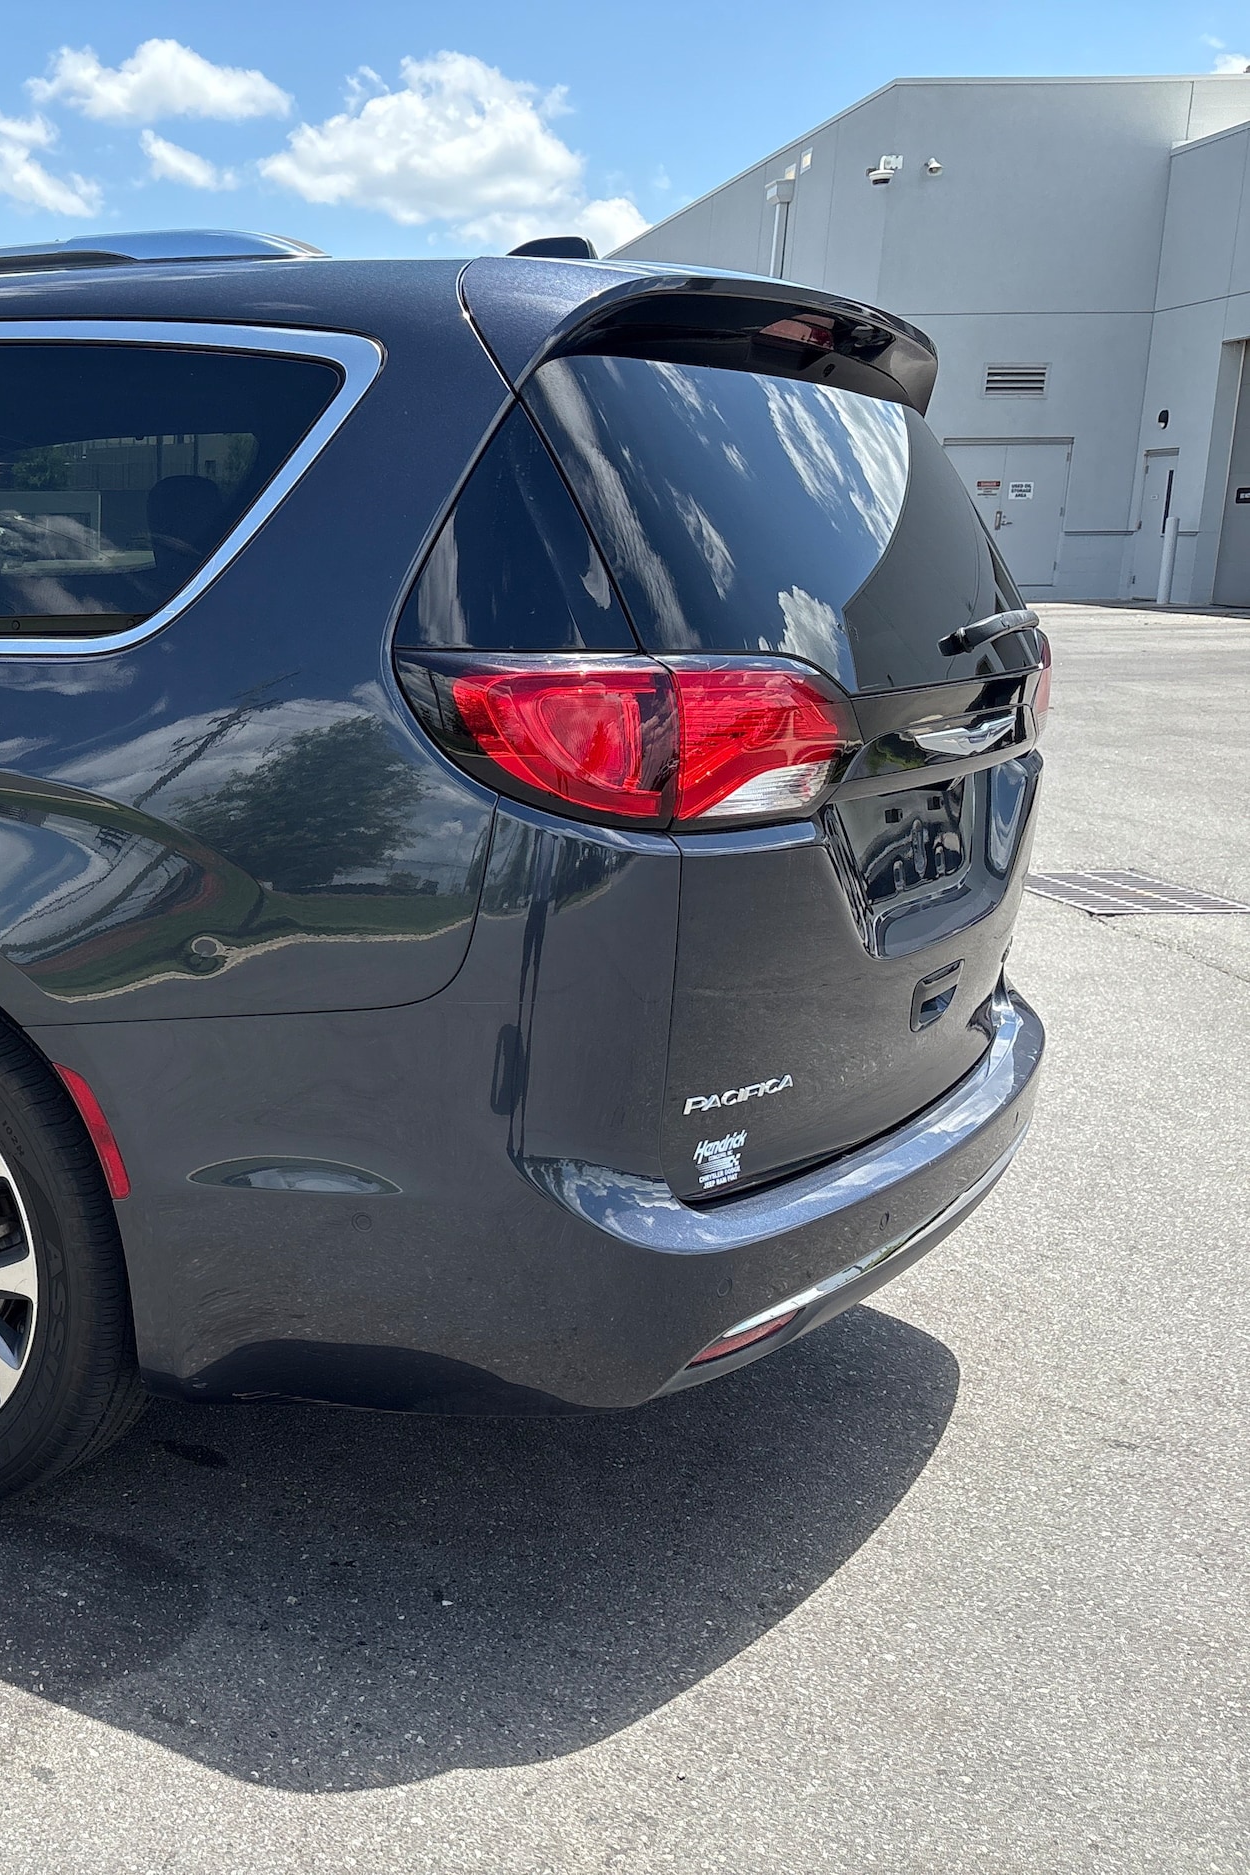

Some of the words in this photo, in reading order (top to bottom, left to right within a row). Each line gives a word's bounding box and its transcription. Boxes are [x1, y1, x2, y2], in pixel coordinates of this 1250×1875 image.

[683, 1074, 793, 1115] PACIFICA
[692, 1129, 748, 1165] Hendrick
[699, 1171, 724, 1183] CHRYSLER
[724, 1165, 741, 1175] DODGE
[703, 1180, 715, 1189] JEEP
[716, 1176, 727, 1185] RAM
[727, 1173, 738, 1182] FIAT
